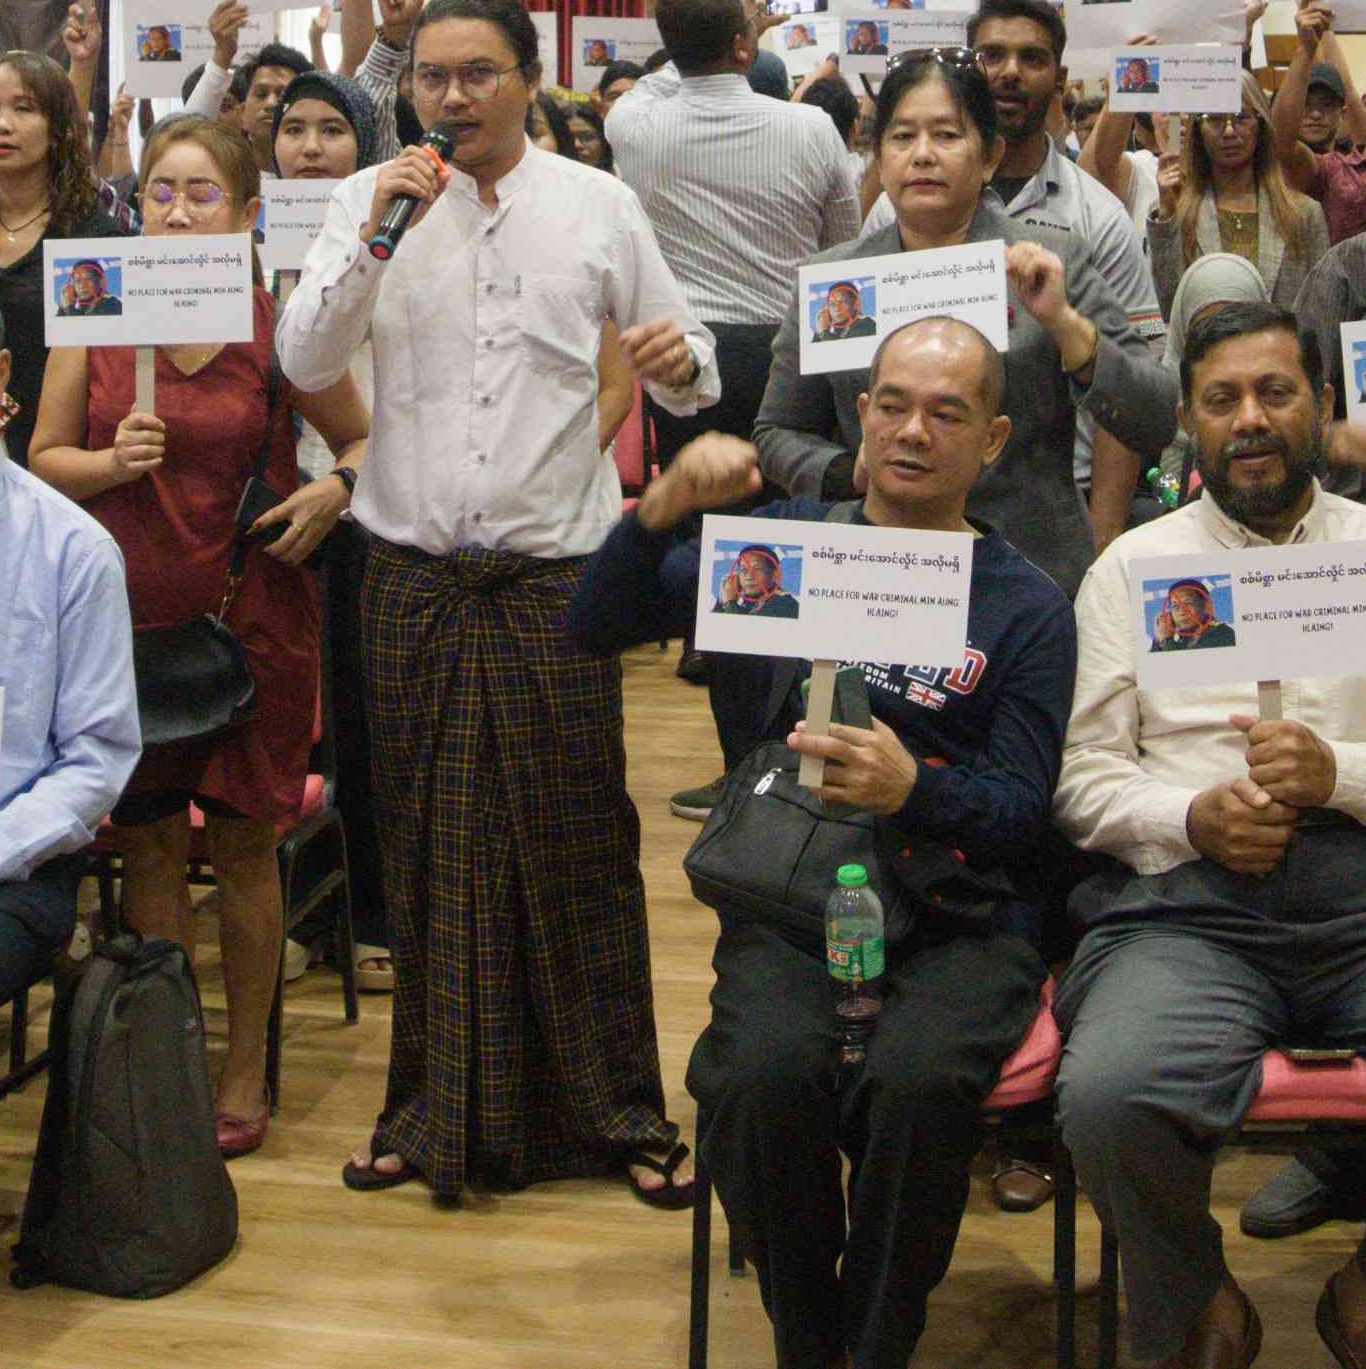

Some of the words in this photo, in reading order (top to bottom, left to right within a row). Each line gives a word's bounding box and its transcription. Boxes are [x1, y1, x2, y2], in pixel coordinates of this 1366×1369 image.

[809, 588, 819, 597] NO
[822, 589, 844, 599] PLACE
[845, 591, 859, 600] FOR
[862, 592, 878, 602] WAR
[881, 593, 917, 604] CRIMINAL
[920, 596, 935, 606] MIN
[937, 597, 959, 607] AUNG
[1242, 614, 1253, 622] NO
[1255, 612, 1277, 622] PLACE
[1278, 610, 1292, 620] FOR
[1295, 609, 1311, 619] WAR
[1313, 606, 1350, 617] CRIMINAL
[1352, 604, 1366, 614] MIN
